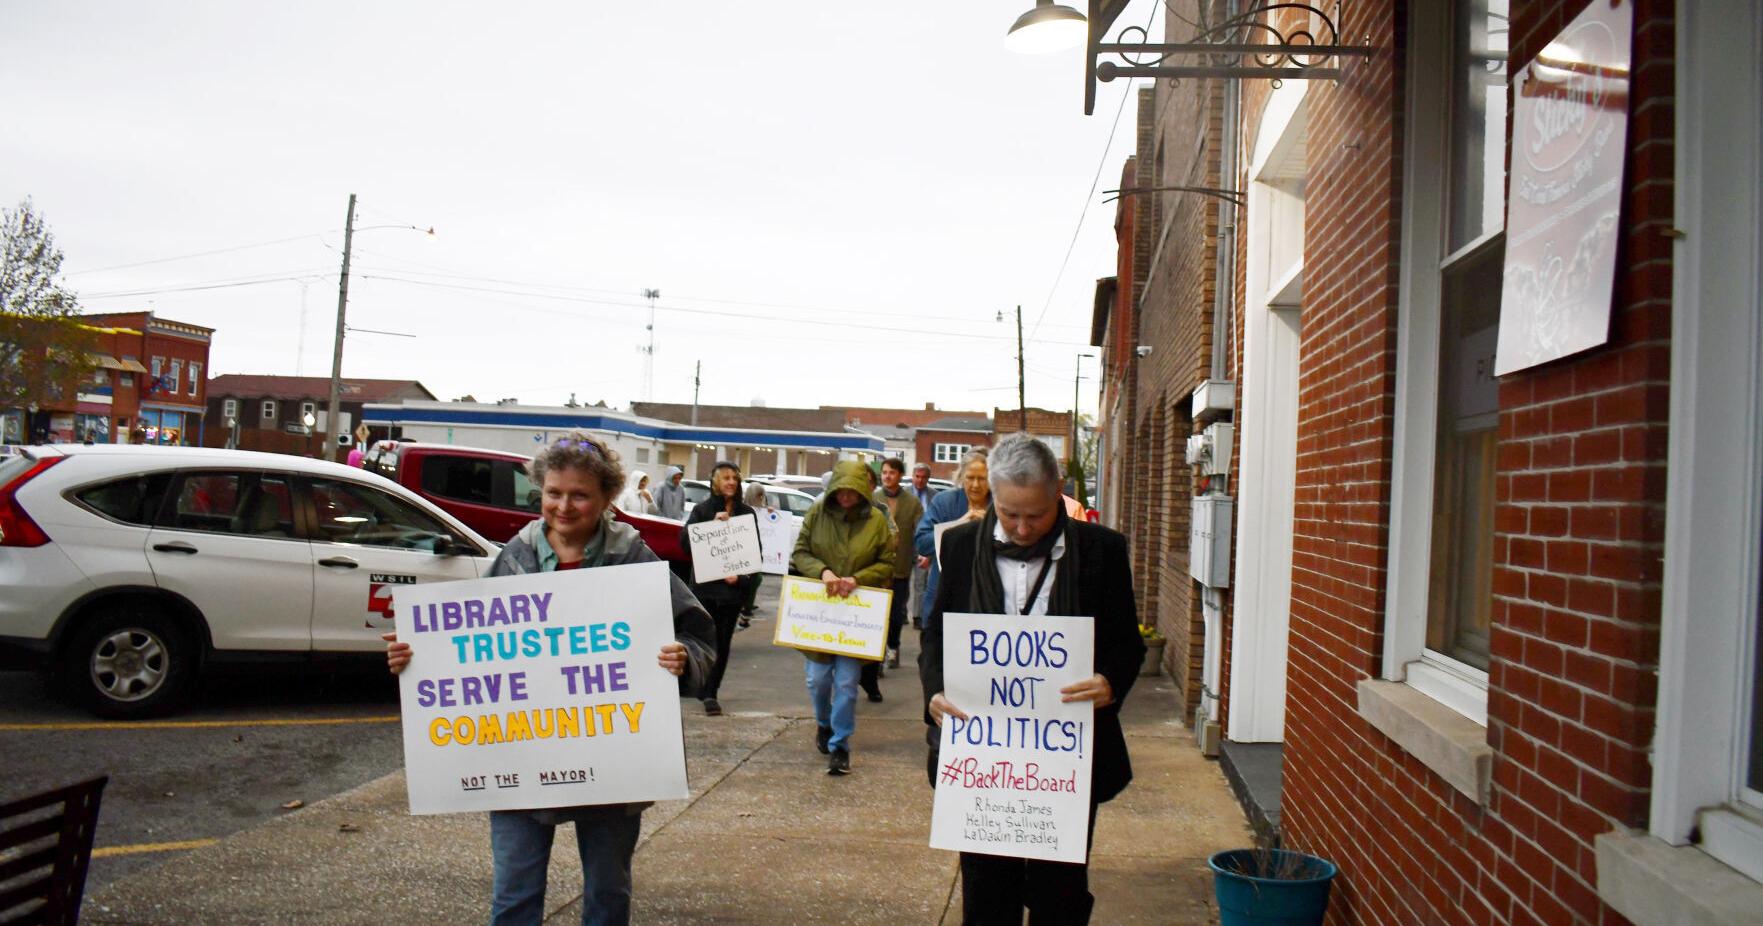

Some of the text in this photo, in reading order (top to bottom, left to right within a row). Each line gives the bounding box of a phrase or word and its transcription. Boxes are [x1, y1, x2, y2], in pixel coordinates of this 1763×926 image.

[691, 524, 751, 545] Separation
[710, 541, 744, 557] Church
[372, 575, 414, 583] WSIL
[722, 560, 751, 573] State
[412, 592, 553, 633] LIBRARY
[452, 621, 631, 664] TRUSTEES
[969, 629, 1068, 669] BOOKS
[417, 661, 629, 707] SERVE THE
[990, 676, 1045, 710] NOT
[428, 702, 645, 746] COMMUNITY
[951, 715, 1083, 759] POLITICS!
[461, 767, 595, 788] NOT THE MAYOR!
[941, 757, 1077, 793] #BackTheBoard
[975, 796, 1053, 816] Rhonda James
[966, 812, 1056, 832] Kelley Sullivan
[964, 829, 1058, 850] LaDawn Bradley
